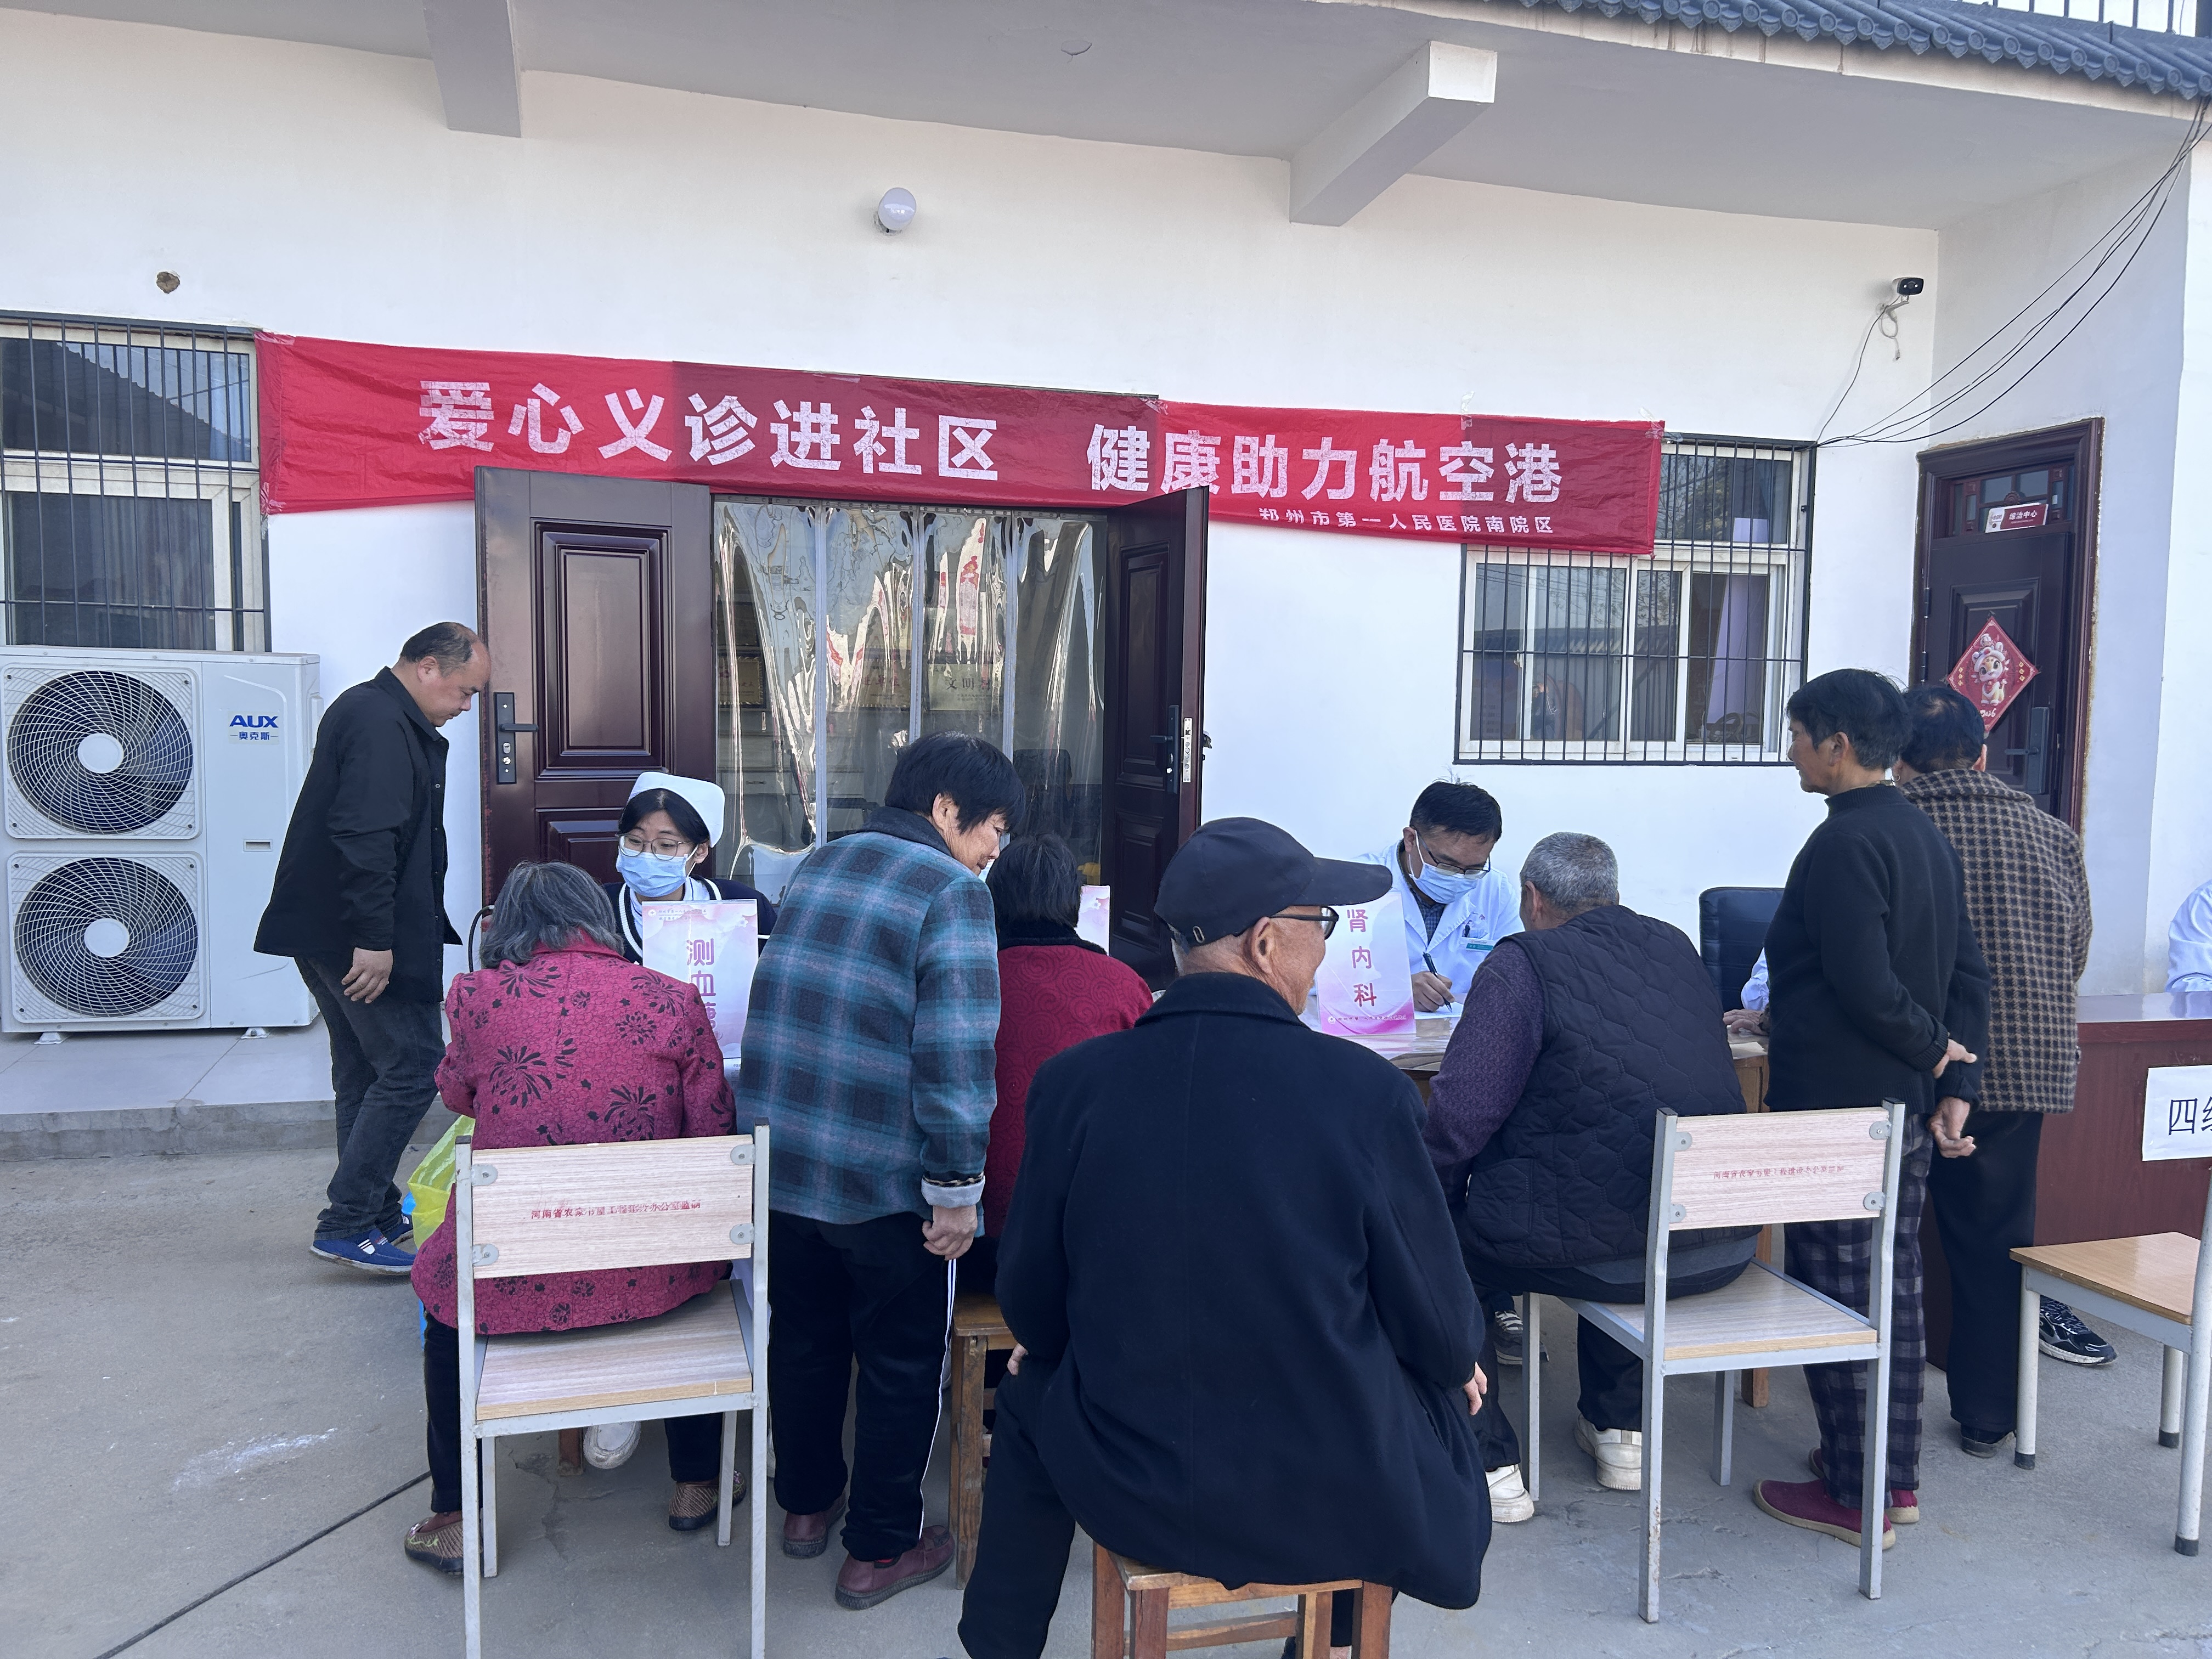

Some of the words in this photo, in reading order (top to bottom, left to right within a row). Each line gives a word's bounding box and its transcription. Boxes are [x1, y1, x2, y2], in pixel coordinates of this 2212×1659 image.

[418, 380, 998, 481] 爱心义诊进社区
[1086, 422, 1561, 504] 健康助力航空港
[1259, 507, 1553, 534] 郑州市第一人民医院南院区
[229, 715, 279, 728] AUX
[239, 731, 270, 741] 奥克斯
[1346, 909, 1377, 1007] 肾内科
